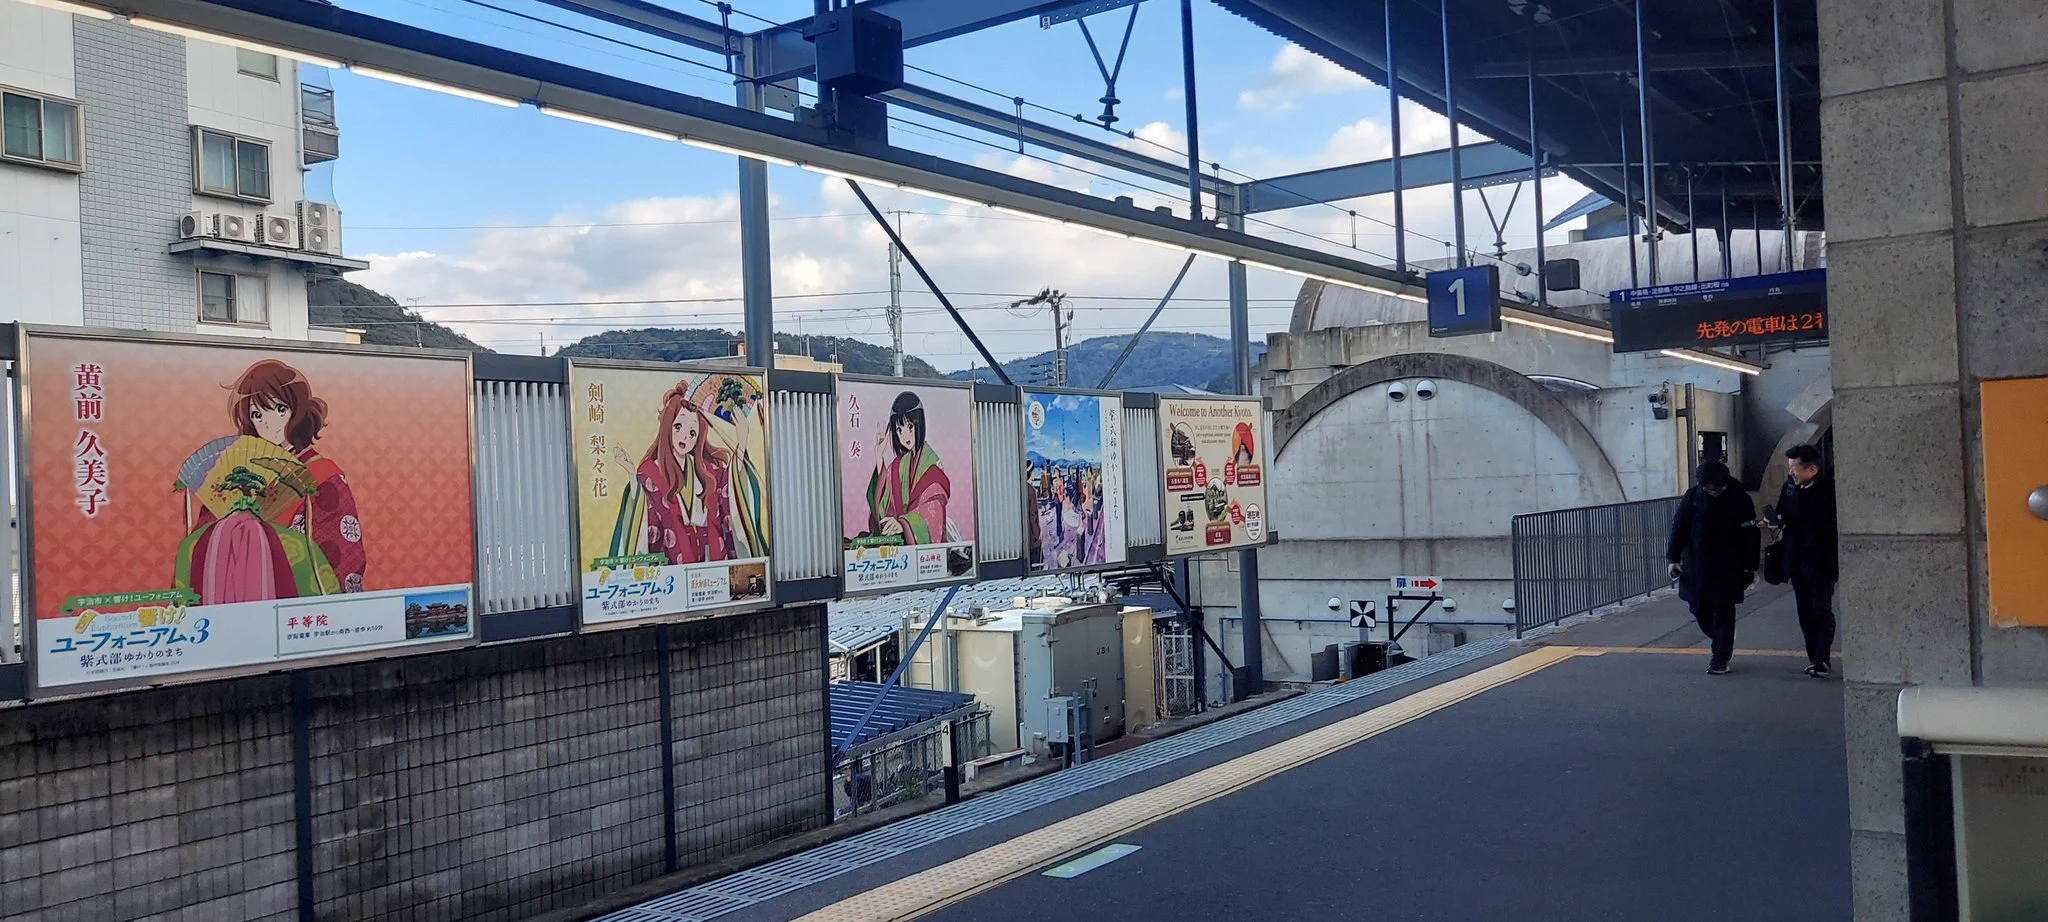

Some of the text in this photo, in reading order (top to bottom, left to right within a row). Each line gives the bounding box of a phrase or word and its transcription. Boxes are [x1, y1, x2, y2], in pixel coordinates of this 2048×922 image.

[1448, 278, 1465, 315] 1
[1619, 291, 1625, 302] 1
[1169, 403, 1200, 417] Welcome
[1201, 407, 1208, 417] to
[1208, 405, 1233, 417] Another
[848, 394, 861, 457] 久石 奏
[73, 363, 108, 515] 黄前 久美子
[588, 382, 608, 498] 剣崎 梨々花
[287, 613, 329, 630] 平等院
[80, 647, 184, 668] 紫式部ゆかりのまち
[942, 724, 949, 736] 4
